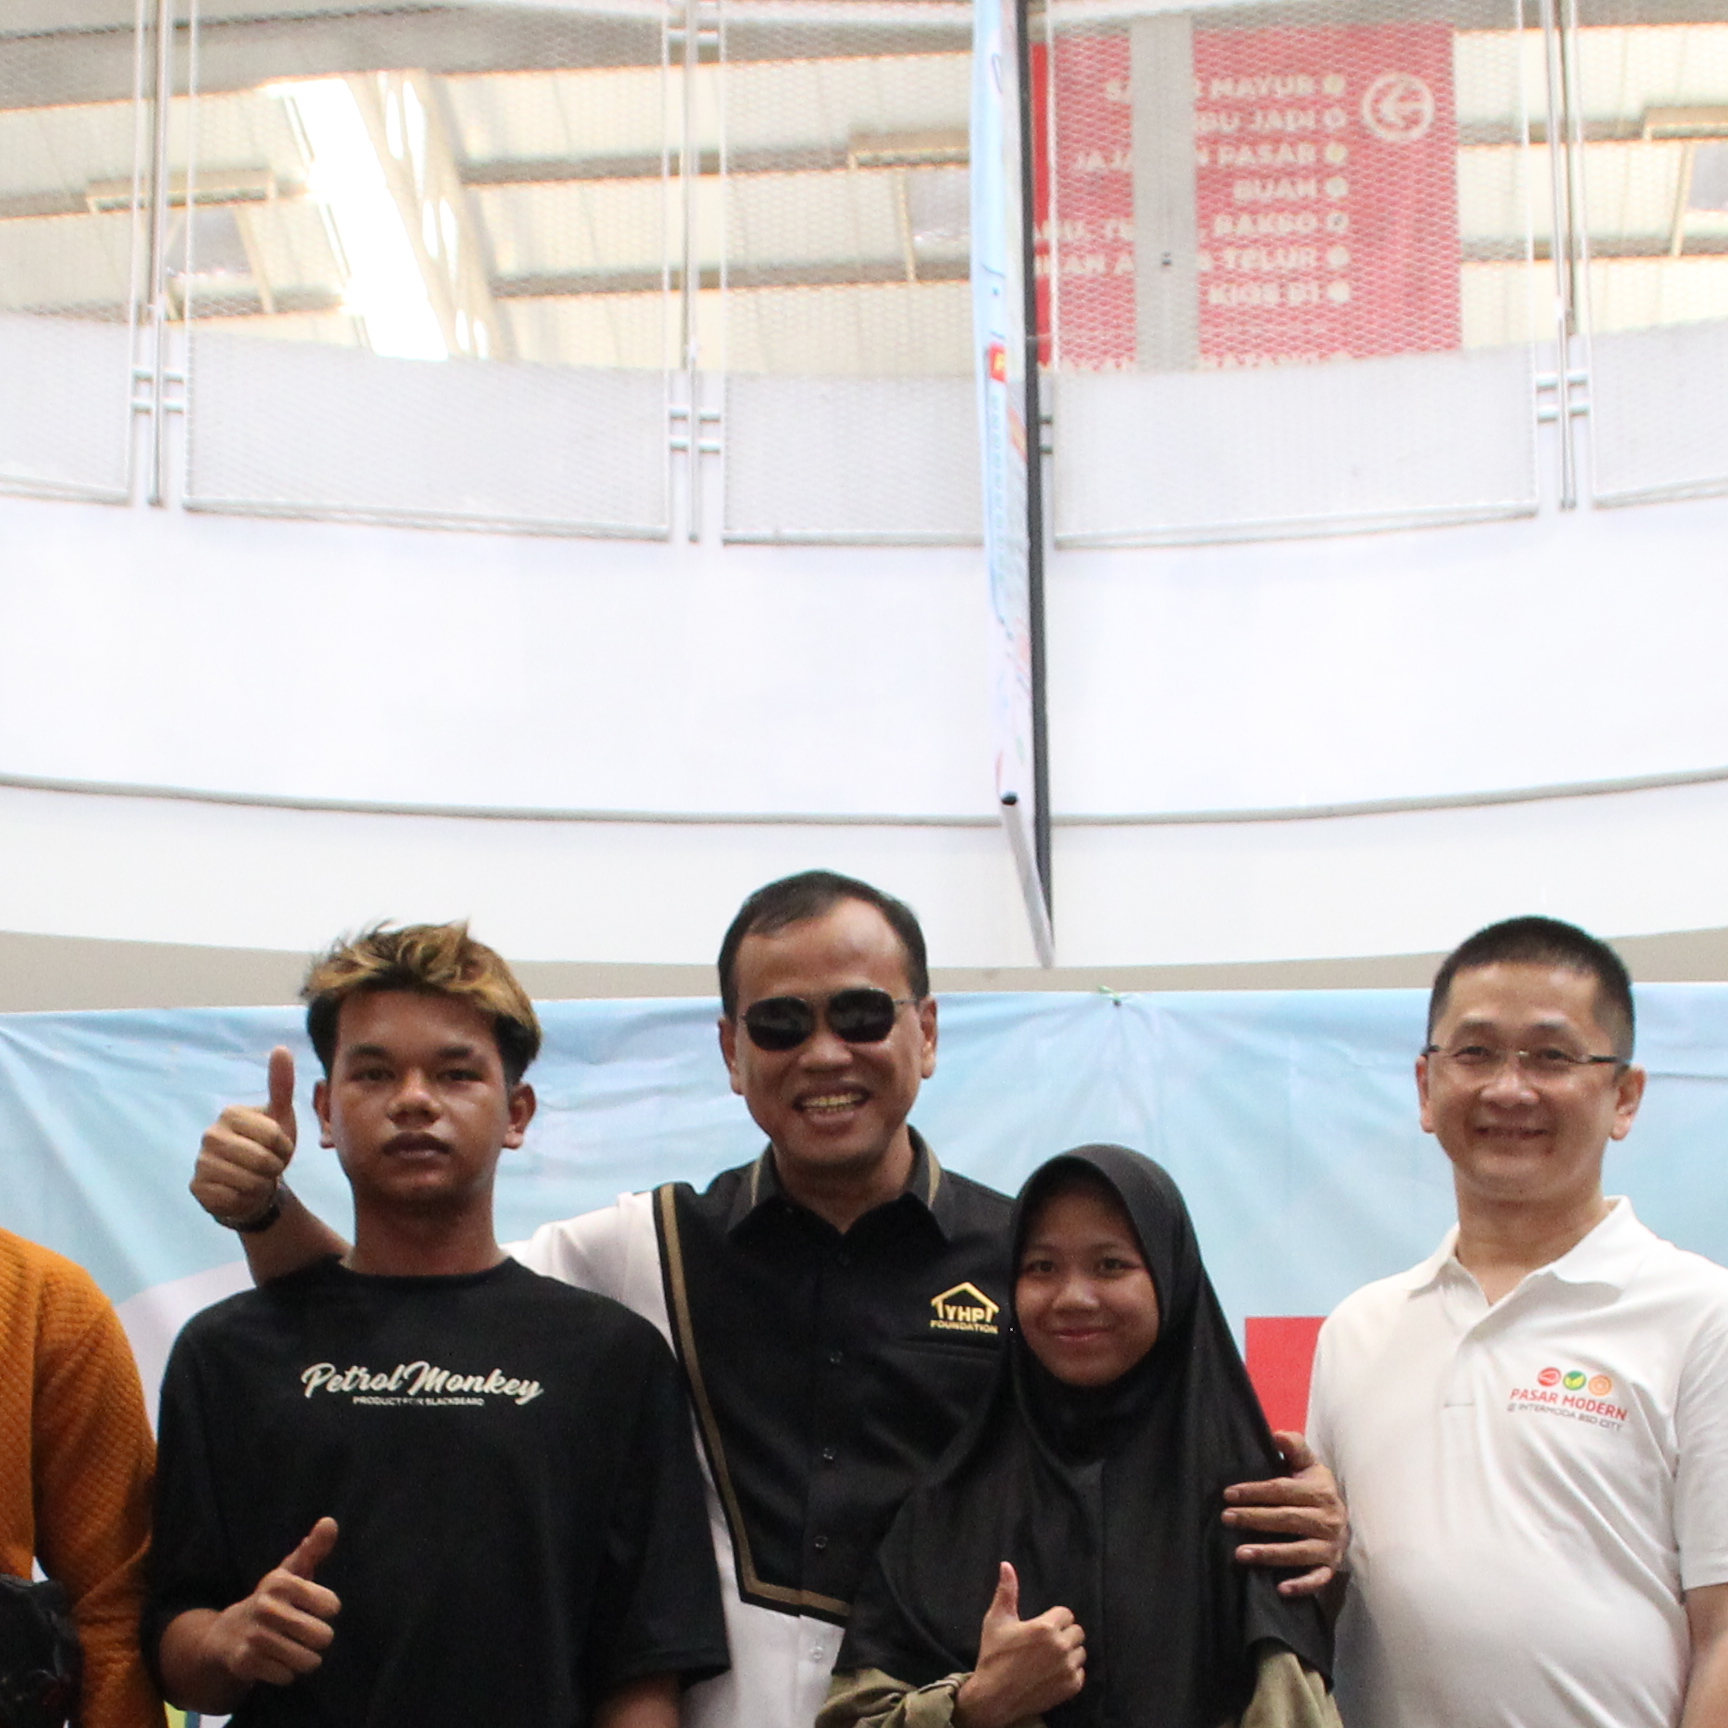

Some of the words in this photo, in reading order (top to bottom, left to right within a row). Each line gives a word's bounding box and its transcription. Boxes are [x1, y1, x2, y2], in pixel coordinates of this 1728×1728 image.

[929, 1319, 1000, 1335] FOUNDATION
[300, 1362, 406, 1399] Petrol
[402, 1360, 545, 1406] Monkey
[1509, 1387, 1559, 1405] PASAR
[1561, 1395, 1629, 1422] MODERN
[1518, 1403, 1576, 1419] INTERMODA
